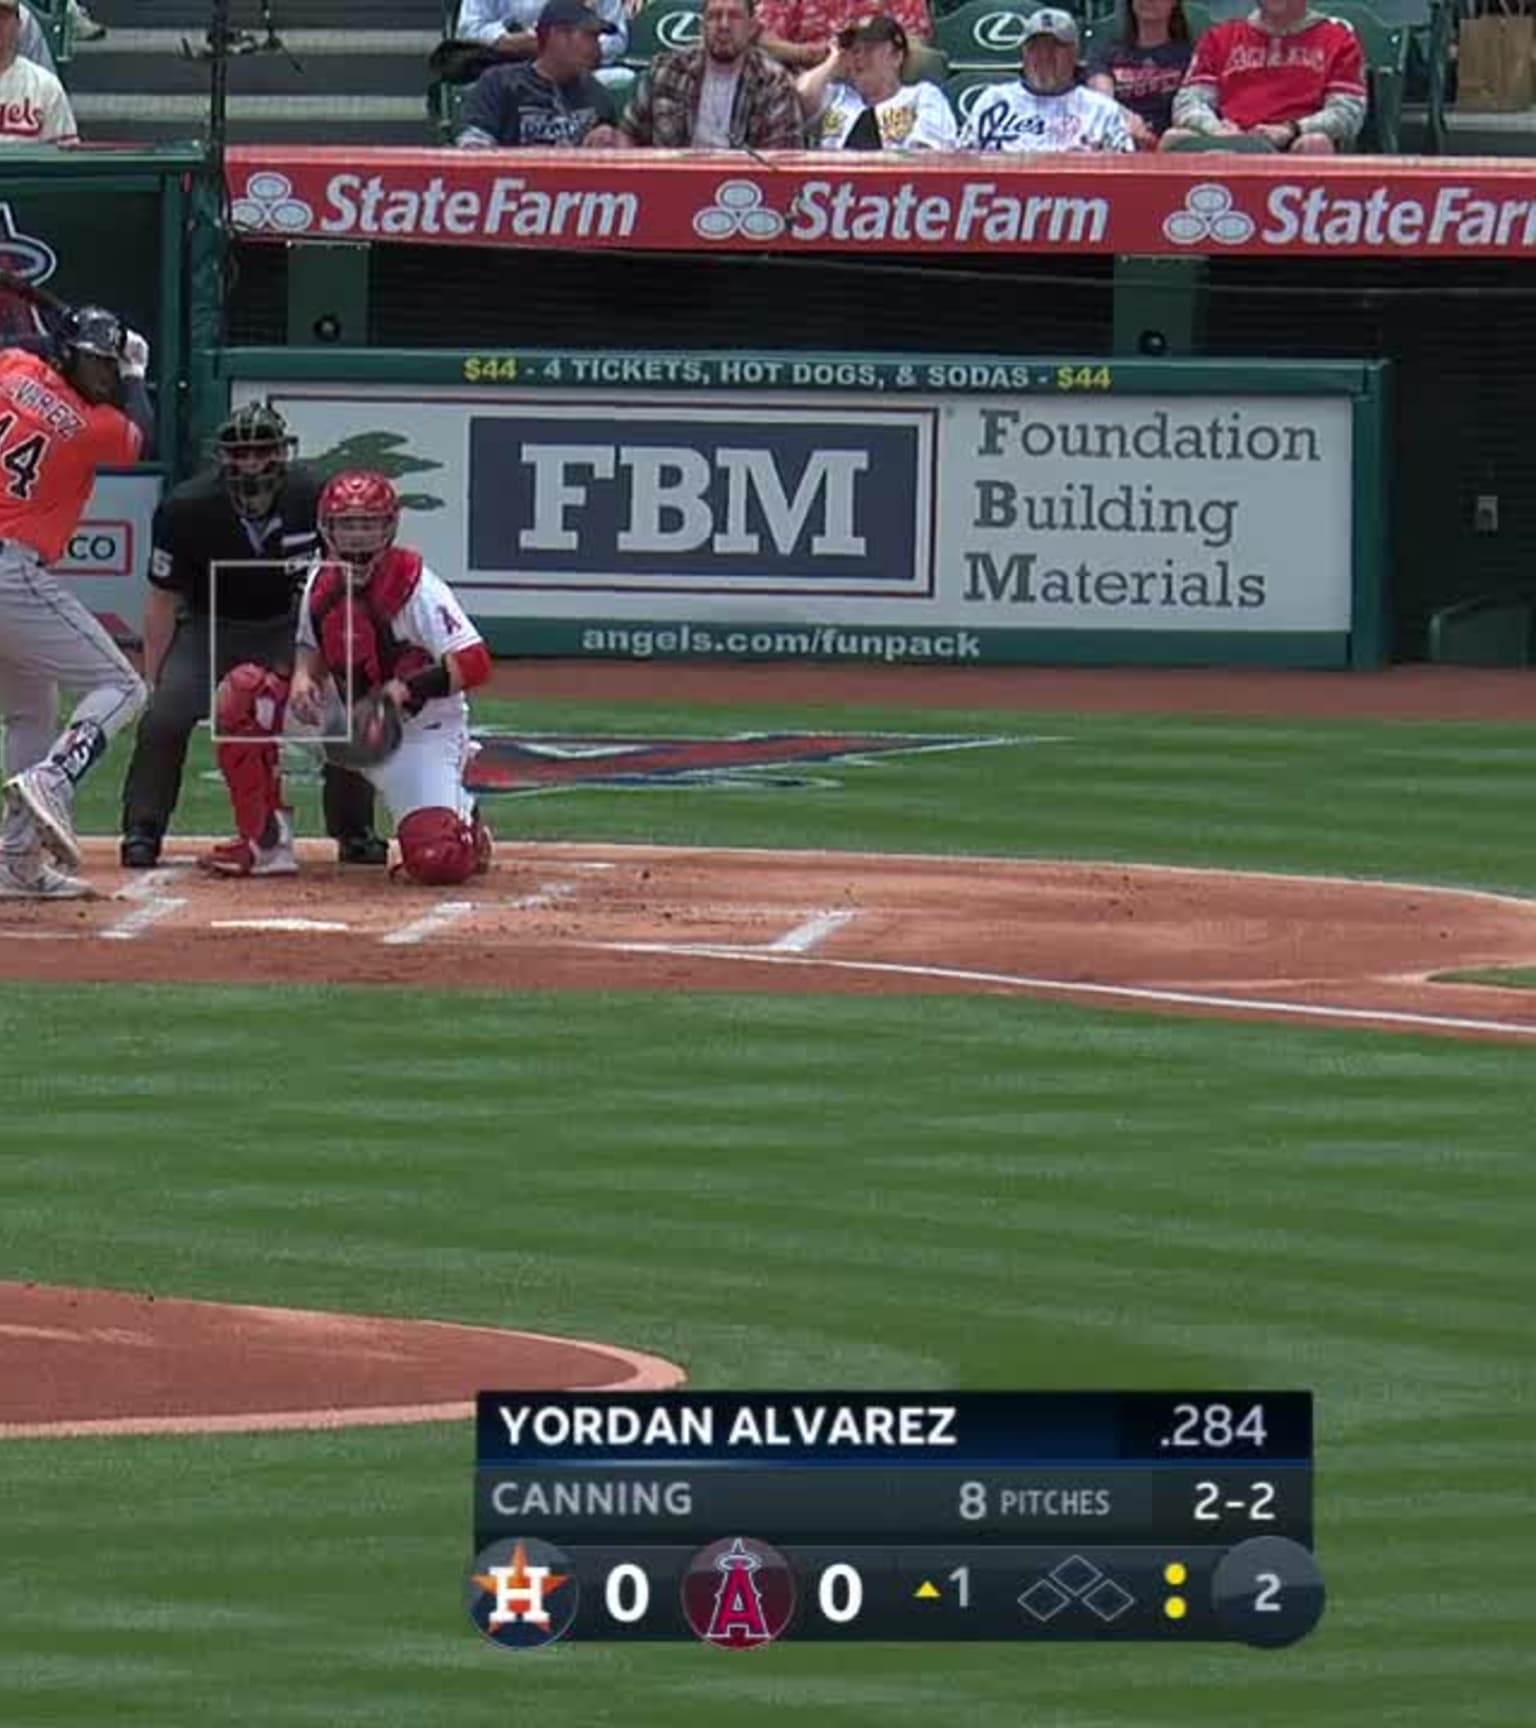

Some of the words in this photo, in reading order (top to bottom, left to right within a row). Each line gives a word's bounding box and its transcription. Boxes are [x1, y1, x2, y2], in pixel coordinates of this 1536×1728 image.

[464, 357, 518, 381] $44
[544, 358, 561, 380] 4
[571, 358, 711, 385] TICKETS,
[720, 360, 783, 383] HOT
[793, 363, 885, 389] DOGS,
[896, 365, 917, 387] &
[928, 366, 1029, 388] SODAS
[1057, 365, 1112, 389] $44
[977, 408, 1322, 462] Foundation
[518, 442, 869, 557] FBM
[972, 479, 1239, 547] Building
[964, 551, 1266, 609] Materials
[581, 625, 982, 661] angels.com/funpack
